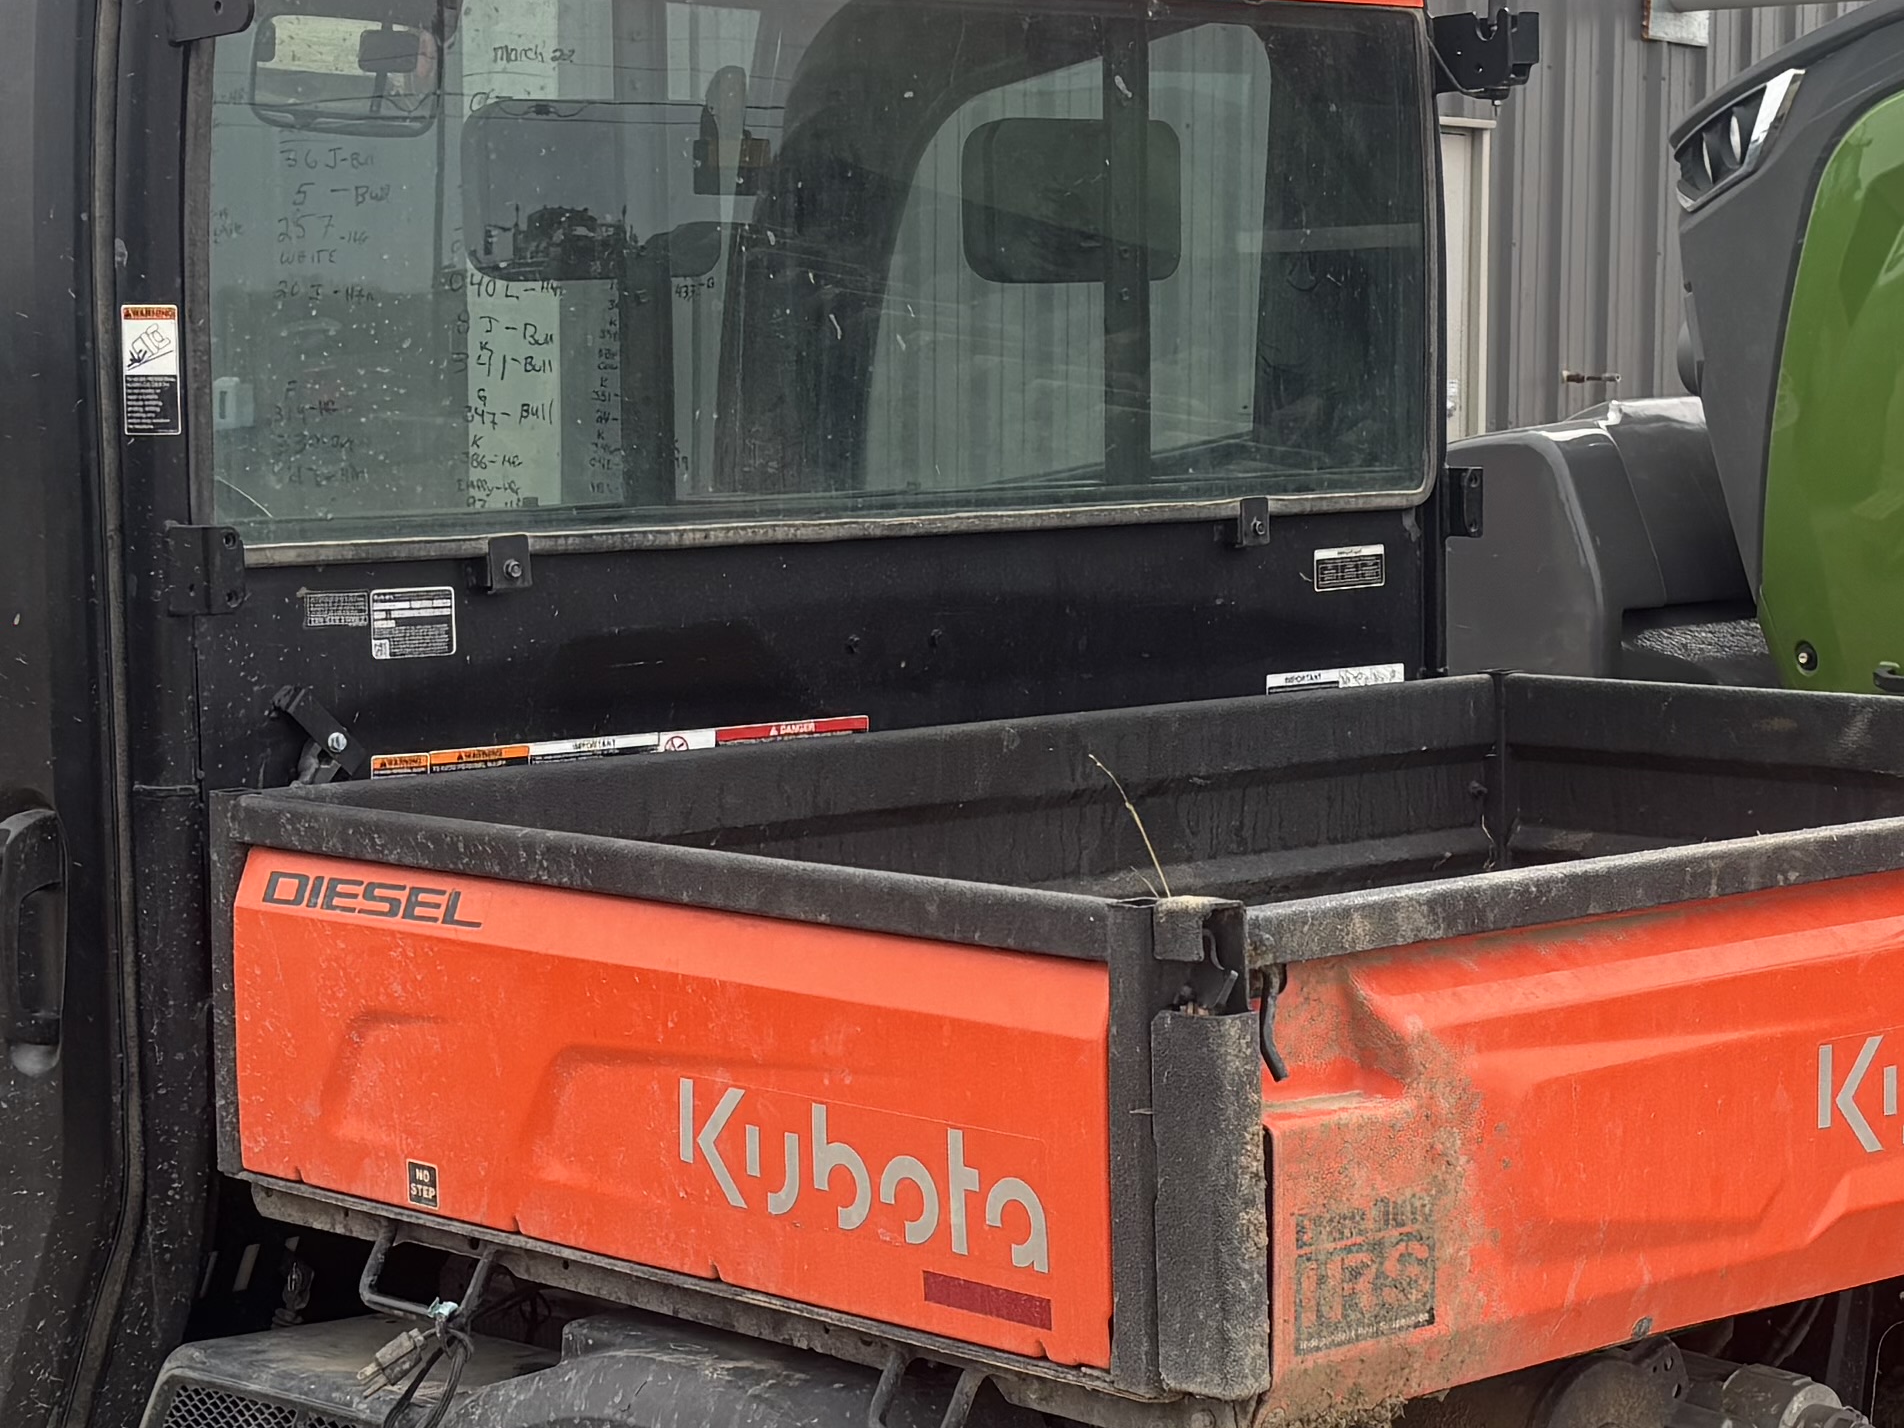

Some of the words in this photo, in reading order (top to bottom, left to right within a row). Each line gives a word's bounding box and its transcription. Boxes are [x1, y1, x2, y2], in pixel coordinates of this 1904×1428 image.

[779, 721, 816, 734] DANGER
[262, 870, 482, 929] DIESEL
[415, 1168, 431, 1183] NO
[678, 1077, 1050, 1274] Kubota
[410, 1183, 436, 1200] STEP
